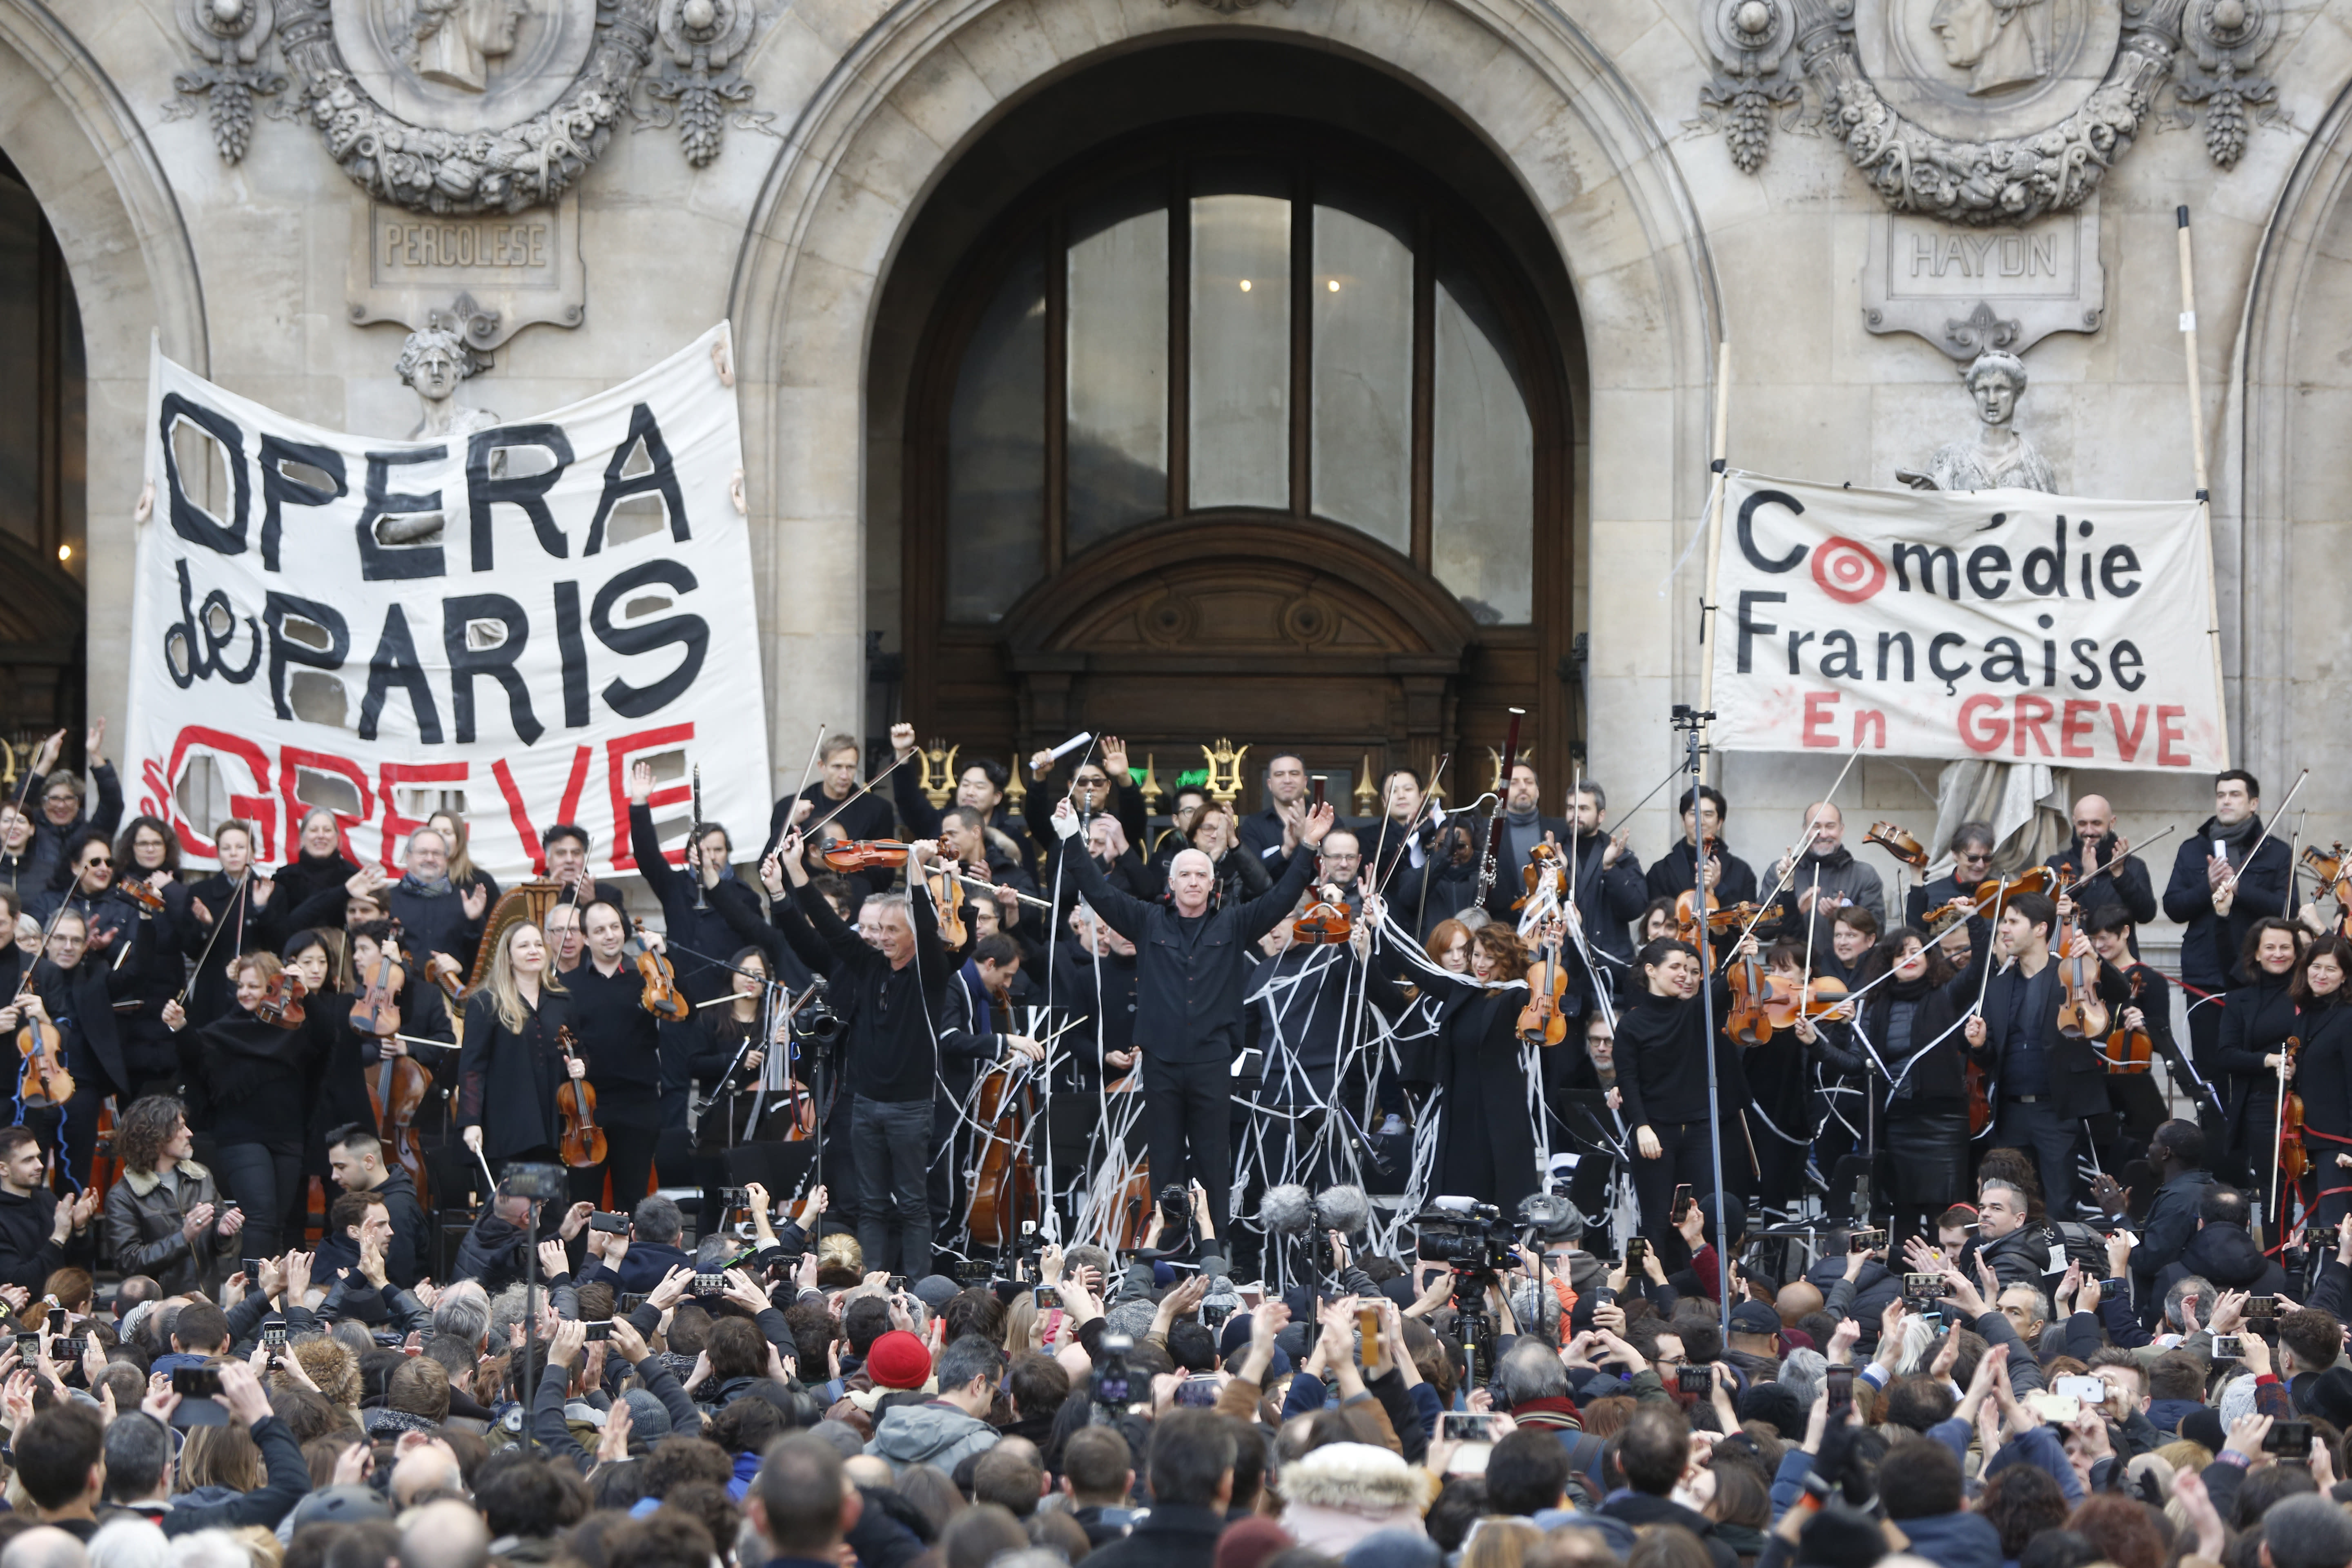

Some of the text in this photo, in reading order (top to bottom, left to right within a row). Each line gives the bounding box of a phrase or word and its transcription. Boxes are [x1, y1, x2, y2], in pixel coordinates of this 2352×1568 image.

[1911, 234, 2057, 277] HAYDN
[160, 392, 692, 581] OPERA
[1737, 490, 2143, 604] Comédie
[165, 558, 710, 747] de PARIS
[1737, 590, 2146, 697] Française
[1802, 691, 2192, 766] En GREVE
[167, 721, 696, 880] GREVE
